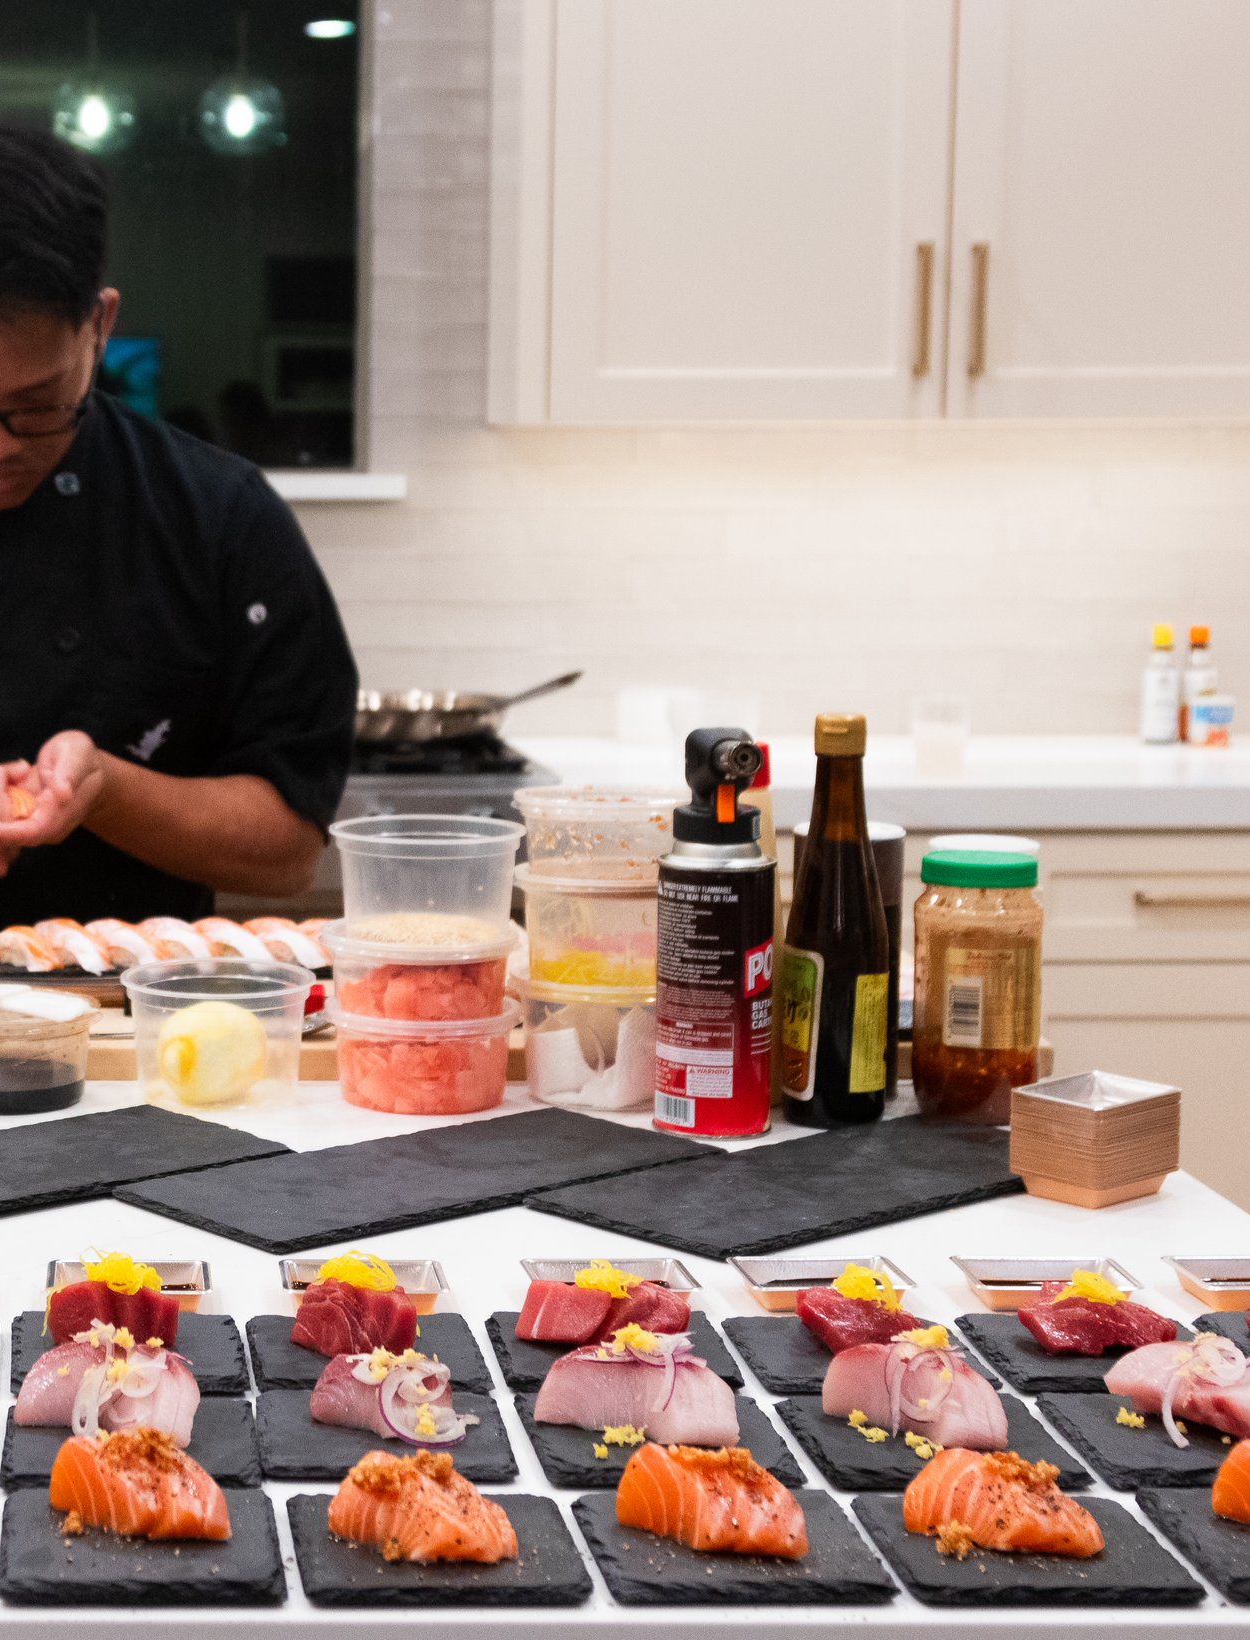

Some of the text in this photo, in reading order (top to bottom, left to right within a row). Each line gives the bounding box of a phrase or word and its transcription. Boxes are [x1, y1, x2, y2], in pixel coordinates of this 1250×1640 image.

[702, 886, 732, 895] FLAMMABLE
[686, 893, 699, 901] NEAR
[701, 894, 711, 902] FIRE
[713, 894, 721, 903] OR
[722, 894, 739, 903] FLAME
[752, 1009, 768, 1021] GAS
[697, 1067, 730, 1075] WARNING
